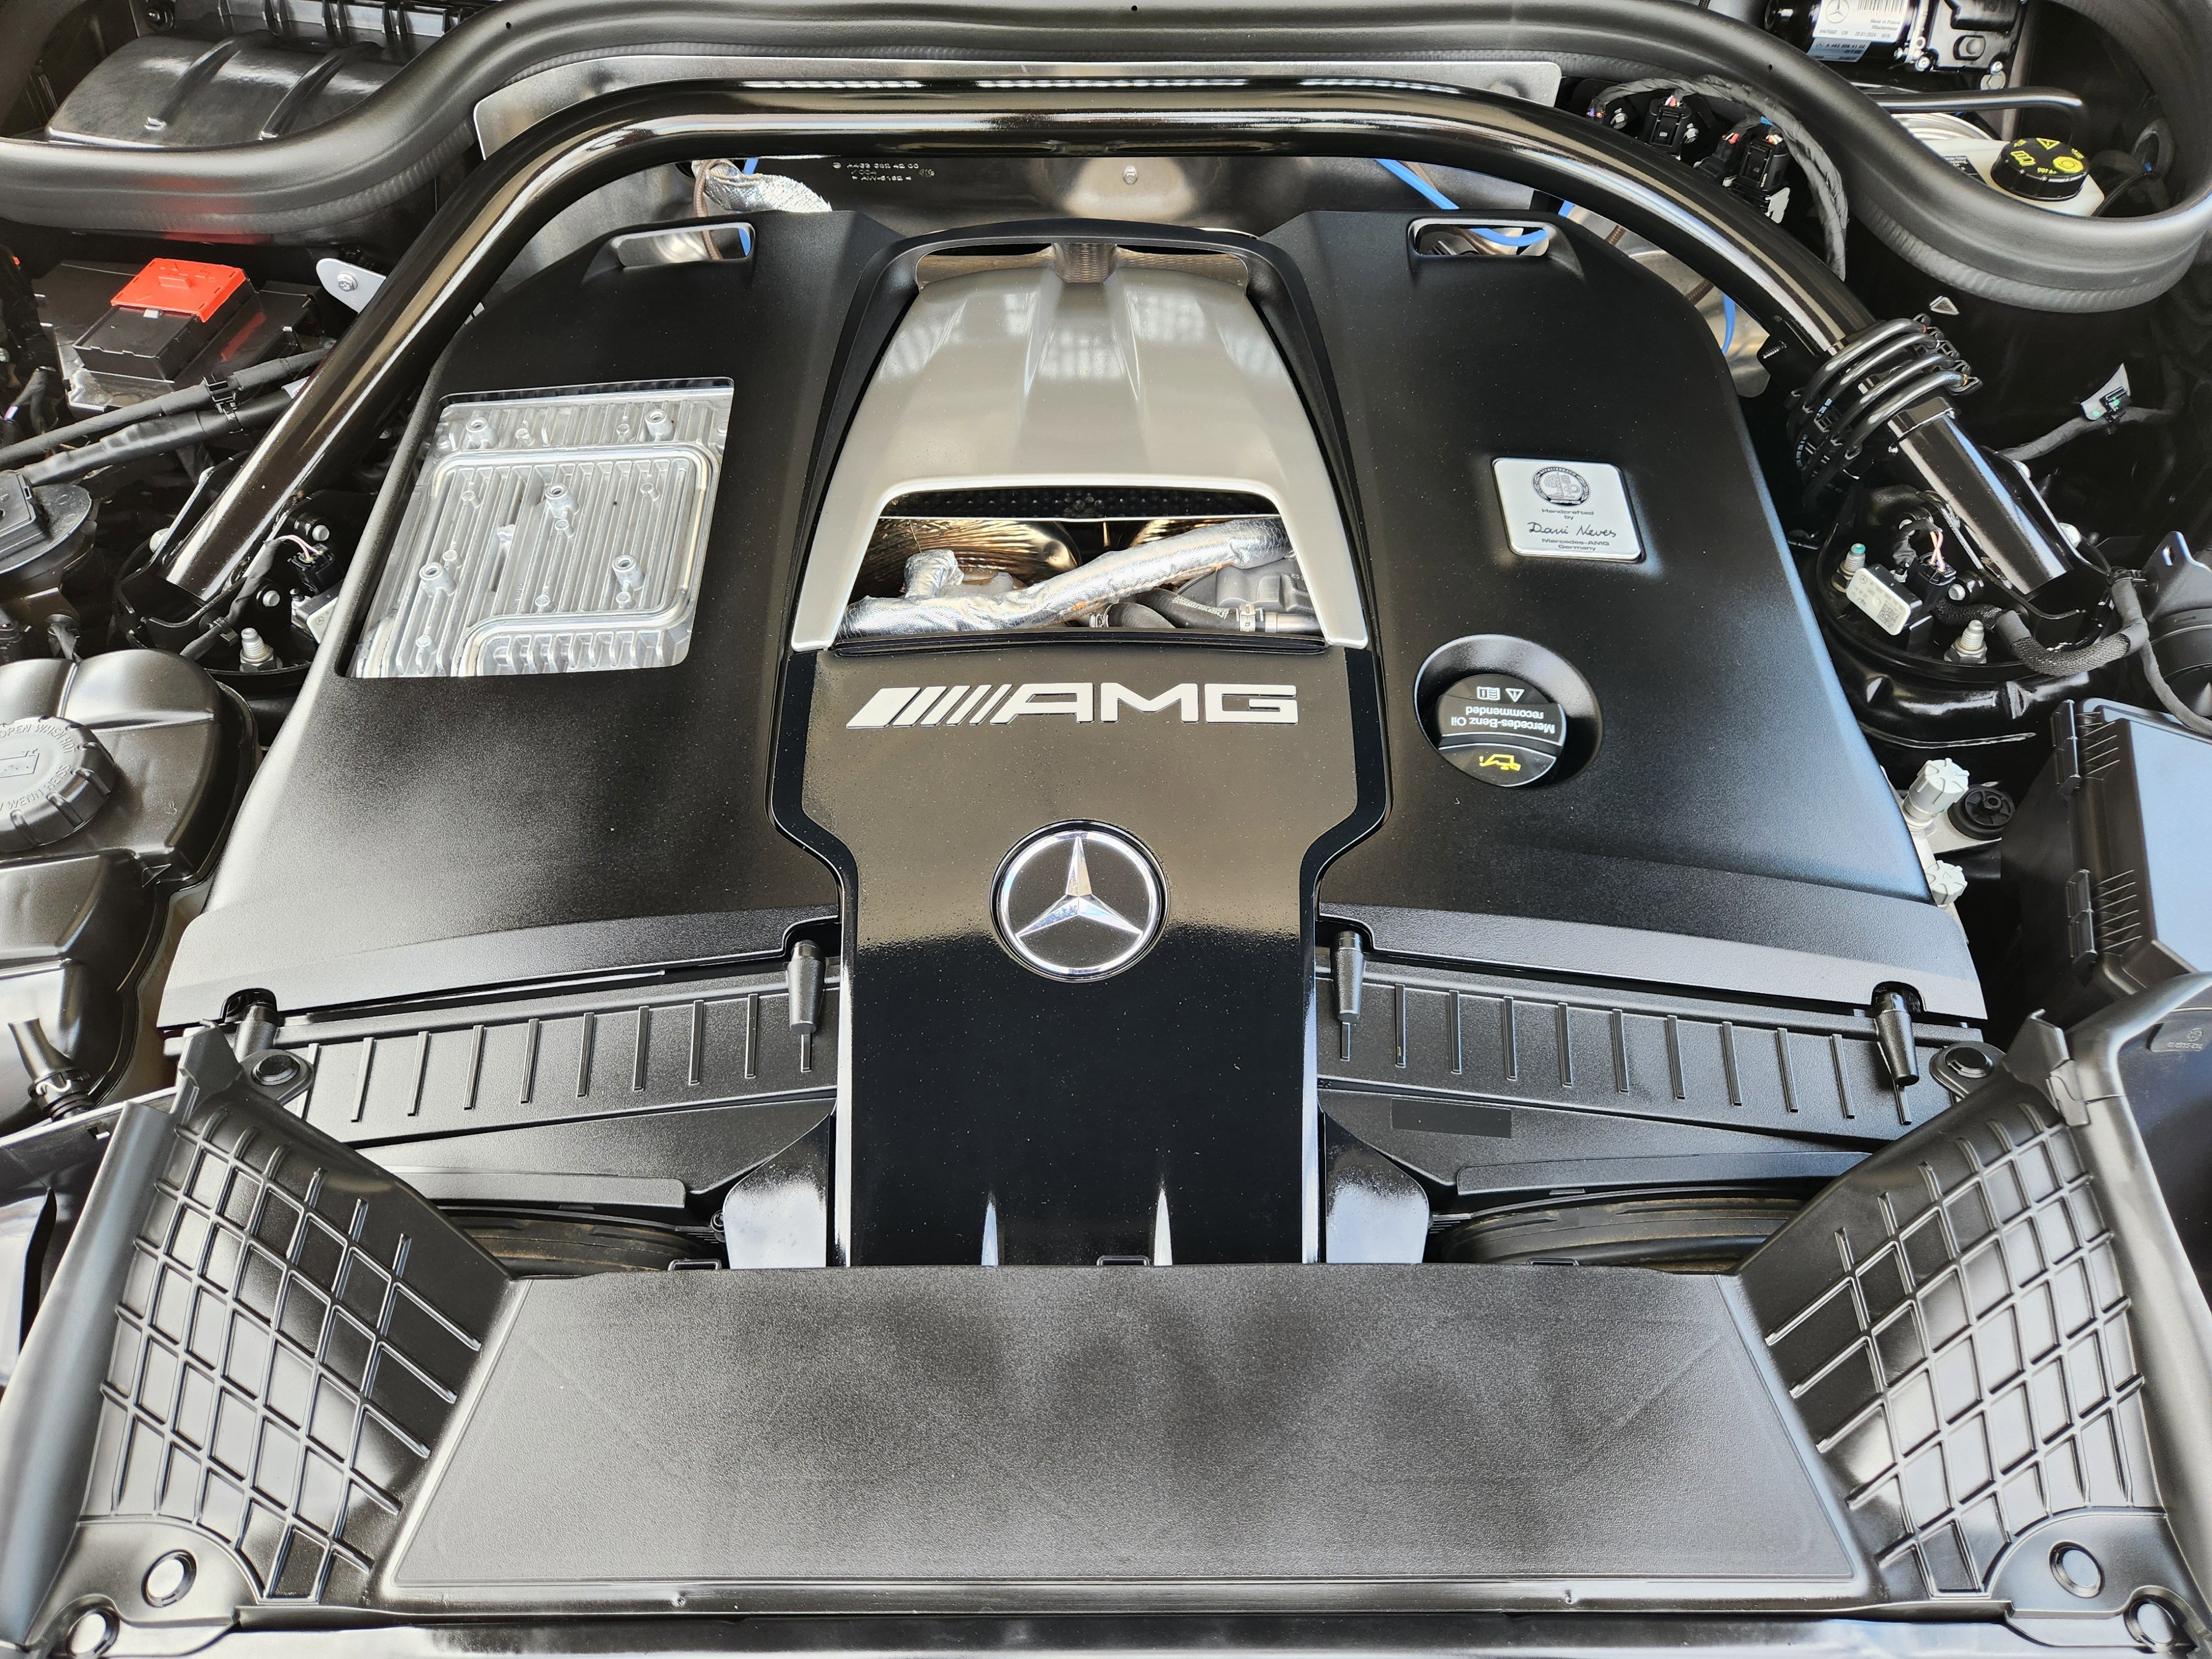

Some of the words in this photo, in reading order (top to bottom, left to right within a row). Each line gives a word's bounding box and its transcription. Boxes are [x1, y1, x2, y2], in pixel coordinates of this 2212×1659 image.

[989, 683, 1299, 724] AMG
[1465, 706, 1545, 719] recommended
[1451, 716, 1467, 727] Oil
[1469, 717, 1555, 734] Mercedes-Benz
[0, 724, 32, 738] OPEN
[34, 724, 66, 740] WHEN
[60, 736, 76, 754] HOT
[8, 789, 44, 810] WENN
[44, 764, 71, 791] HEISS
